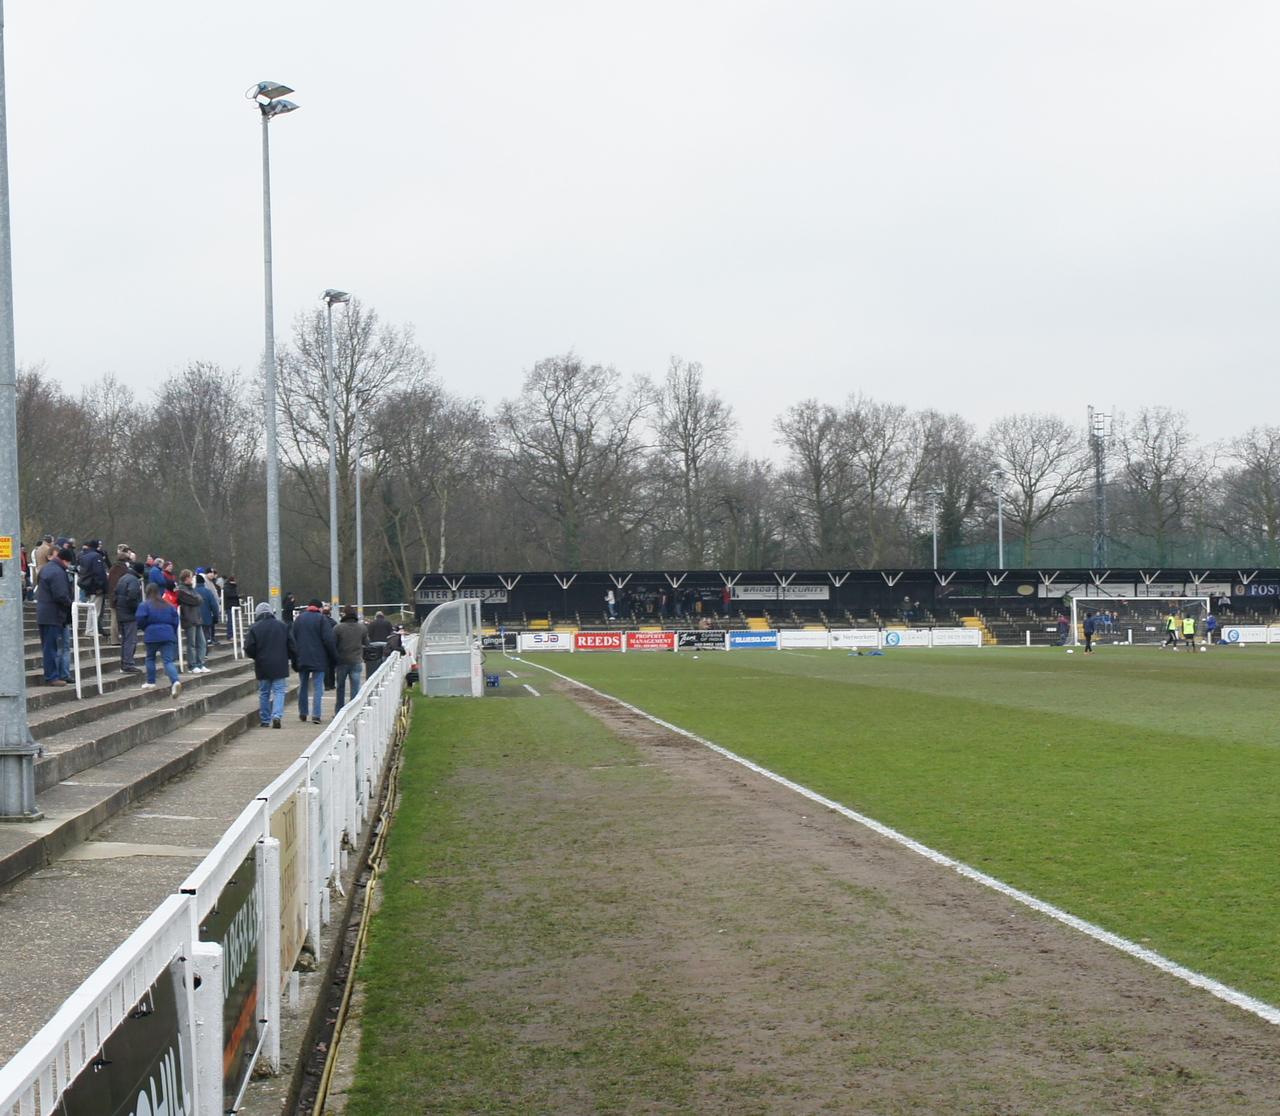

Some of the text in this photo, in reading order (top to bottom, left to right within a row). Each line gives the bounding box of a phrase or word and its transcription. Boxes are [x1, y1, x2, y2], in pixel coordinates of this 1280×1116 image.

[419, 590, 448, 599] INTER
[489, 590, 506, 599] LTD
[578, 636, 620, 646] REEDS
